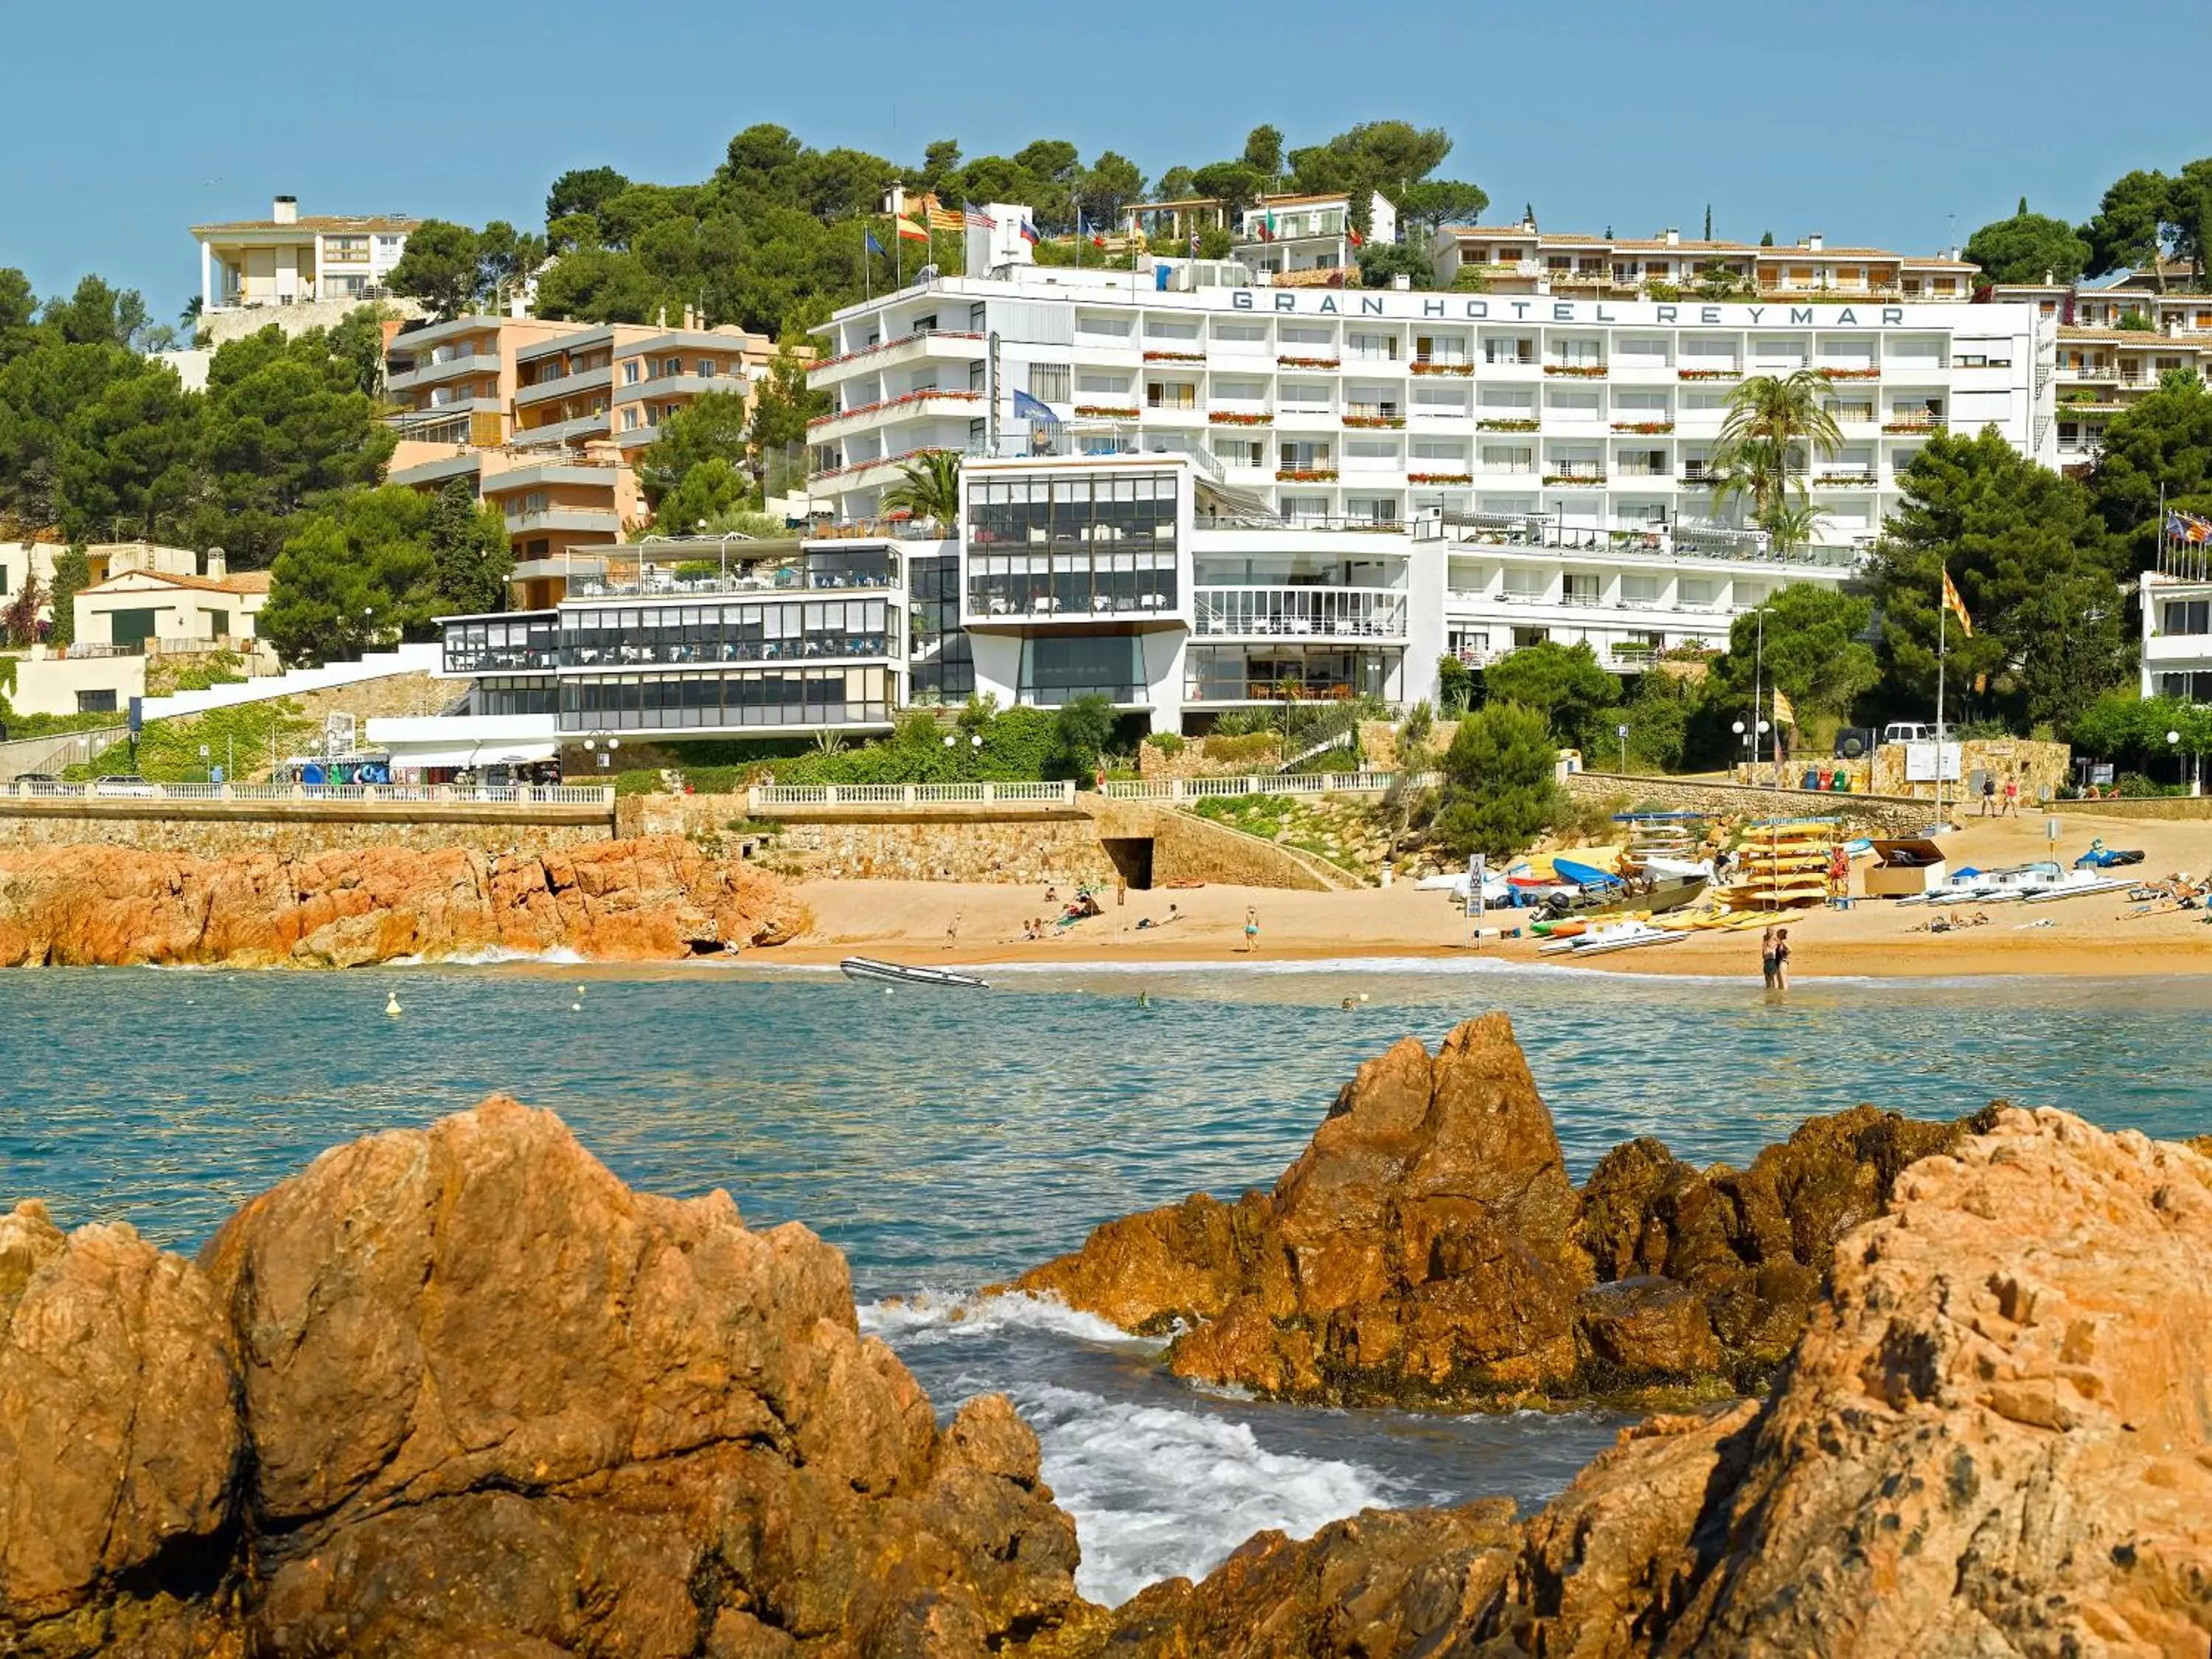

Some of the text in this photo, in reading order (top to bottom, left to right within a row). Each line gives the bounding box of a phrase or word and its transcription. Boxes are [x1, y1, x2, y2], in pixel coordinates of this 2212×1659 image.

[1233, 291, 1904, 325] GRAN HOTEL REYMAR
